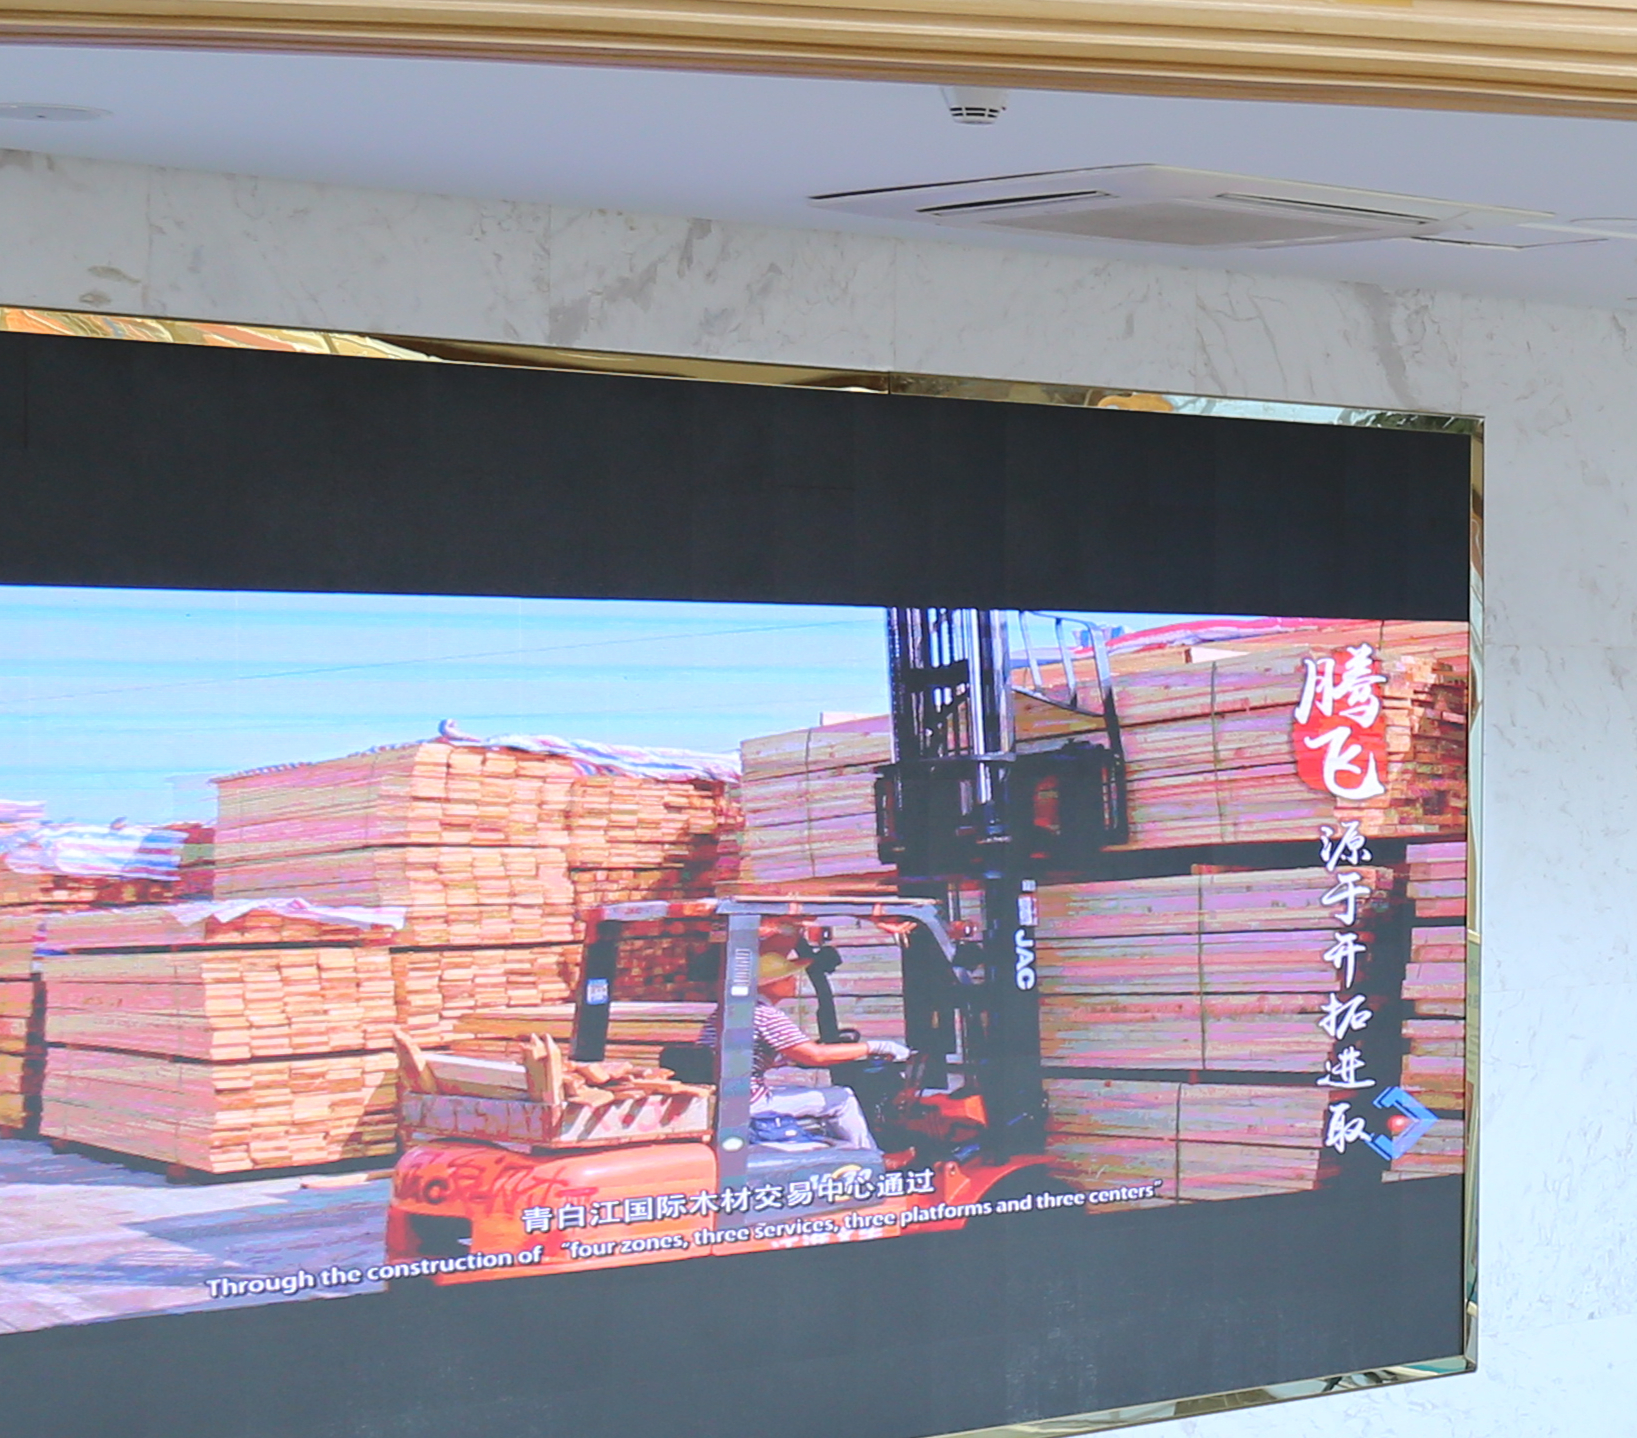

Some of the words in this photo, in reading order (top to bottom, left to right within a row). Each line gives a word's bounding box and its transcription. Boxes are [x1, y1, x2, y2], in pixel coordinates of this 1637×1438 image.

[1293, 643, 1389, 801] 腾飞
[1015, 929, 1035, 989] JAC
[1316, 823, 1376, 1153] 源于开拓进取
[206, 1271, 315, 1298] Through
[320, 1268, 362, 1287] the
[367, 1250, 513, 1282] construction
[518, 1244, 543, 1265] of
[621, 1234, 689, 1254] zones,
[694, 1226, 750, 1247] three
[755, 1218, 840, 1240] services,
[844, 1211, 896, 1230] three
[900, 1197, 993, 1227] platforms
[996, 1193, 1033, 1214] and
[1036, 1189, 1085, 1210] three
[522, 1168, 935, 1232] 青白江国际木材交易中心通过
